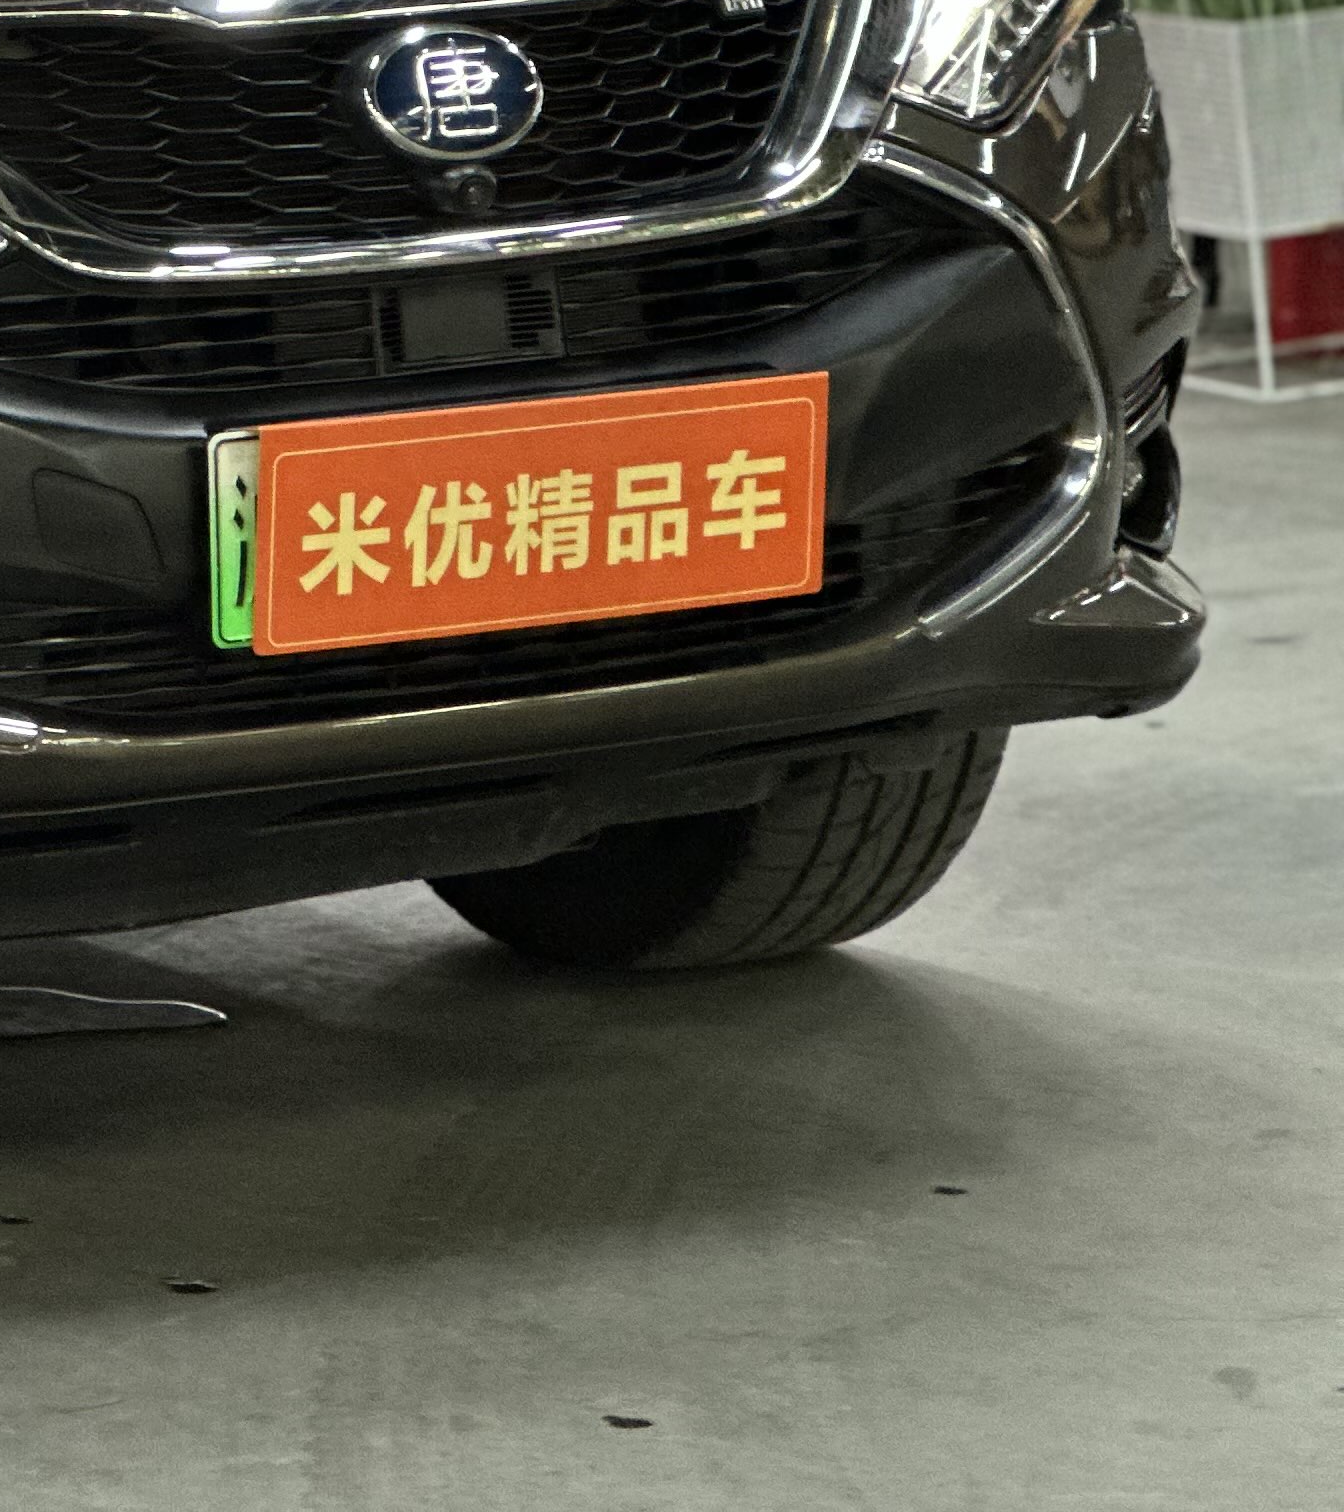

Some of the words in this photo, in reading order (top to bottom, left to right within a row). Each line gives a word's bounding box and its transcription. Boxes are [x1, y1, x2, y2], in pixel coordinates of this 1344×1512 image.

[297, 448, 787, 595] 米优精品车
